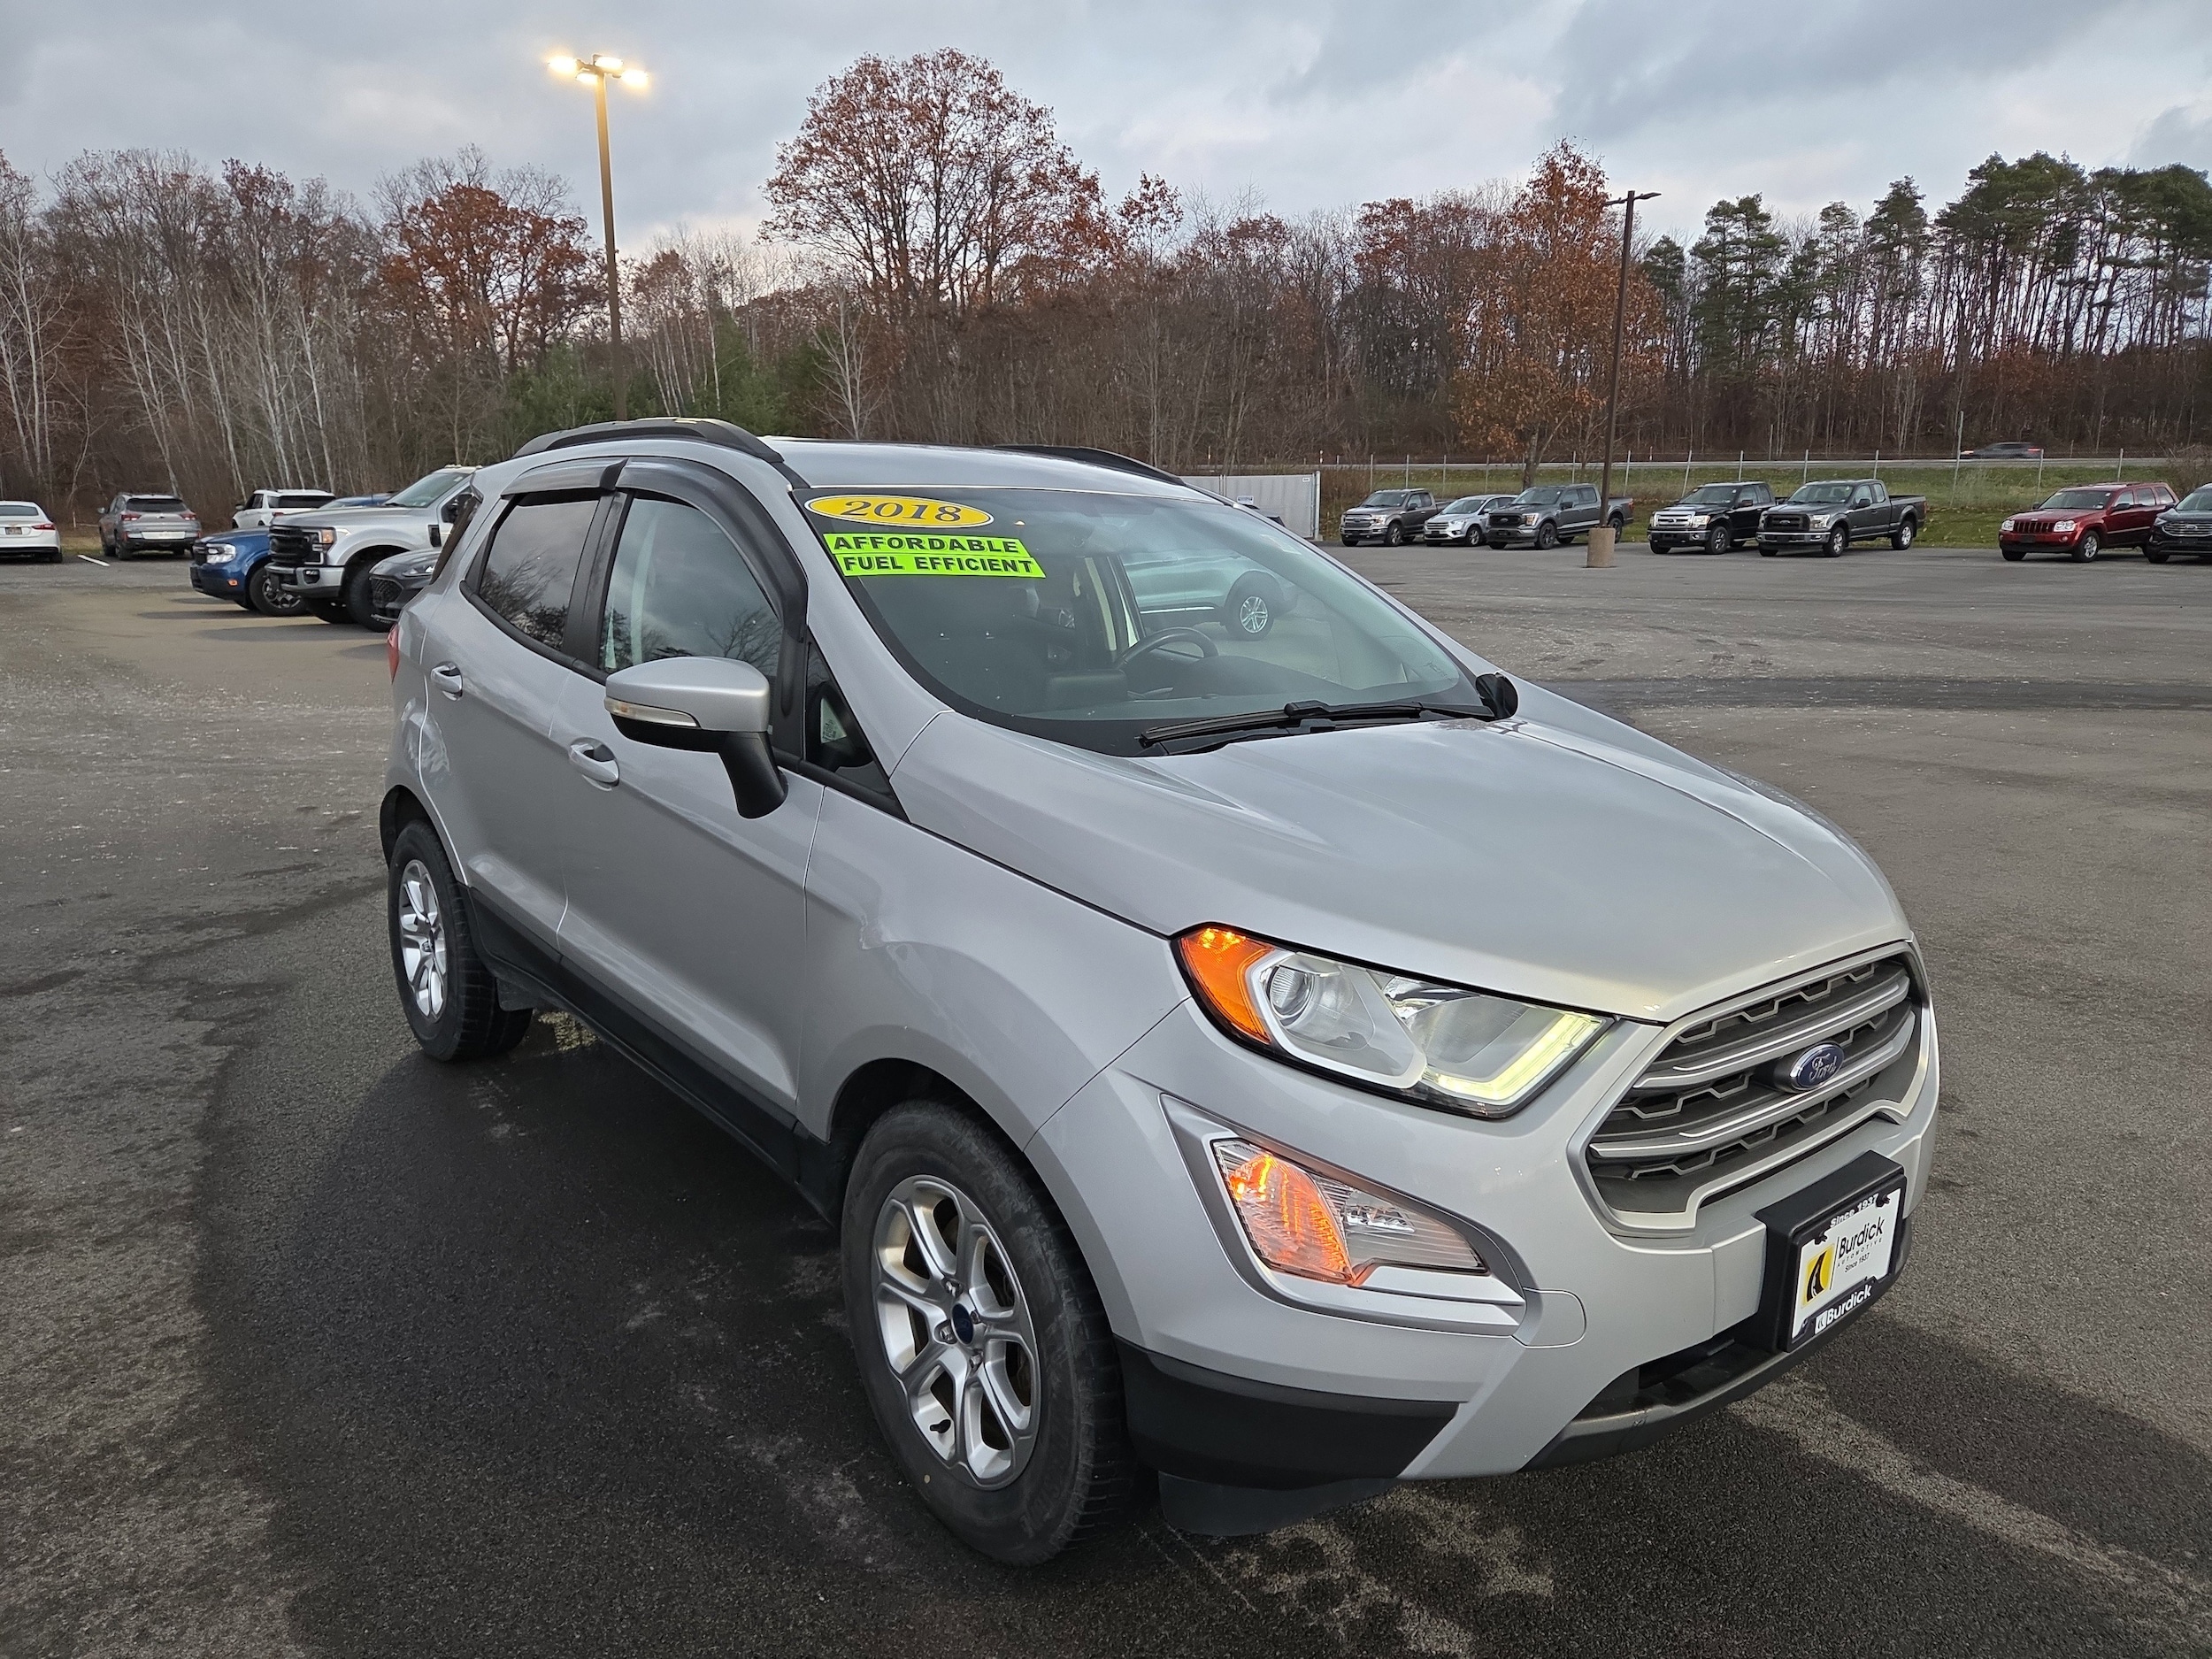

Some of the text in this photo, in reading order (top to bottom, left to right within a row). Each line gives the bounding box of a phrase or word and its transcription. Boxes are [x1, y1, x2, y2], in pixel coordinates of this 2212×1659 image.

[840, 500, 962, 523] 2018
[833, 536, 1019, 554] AFFORDABLE
[843, 555, 1035, 573] FUEL EFFICIENT
[1809, 1053, 1838, 1083] Ford
[1830, 1193, 1879, 1228] Since 1937
[1837, 1237, 1883, 1269] AUTOMOTIVE
[1839, 1216, 1885, 1259] Burdick
[1826, 1284, 1872, 1325] Burdick
